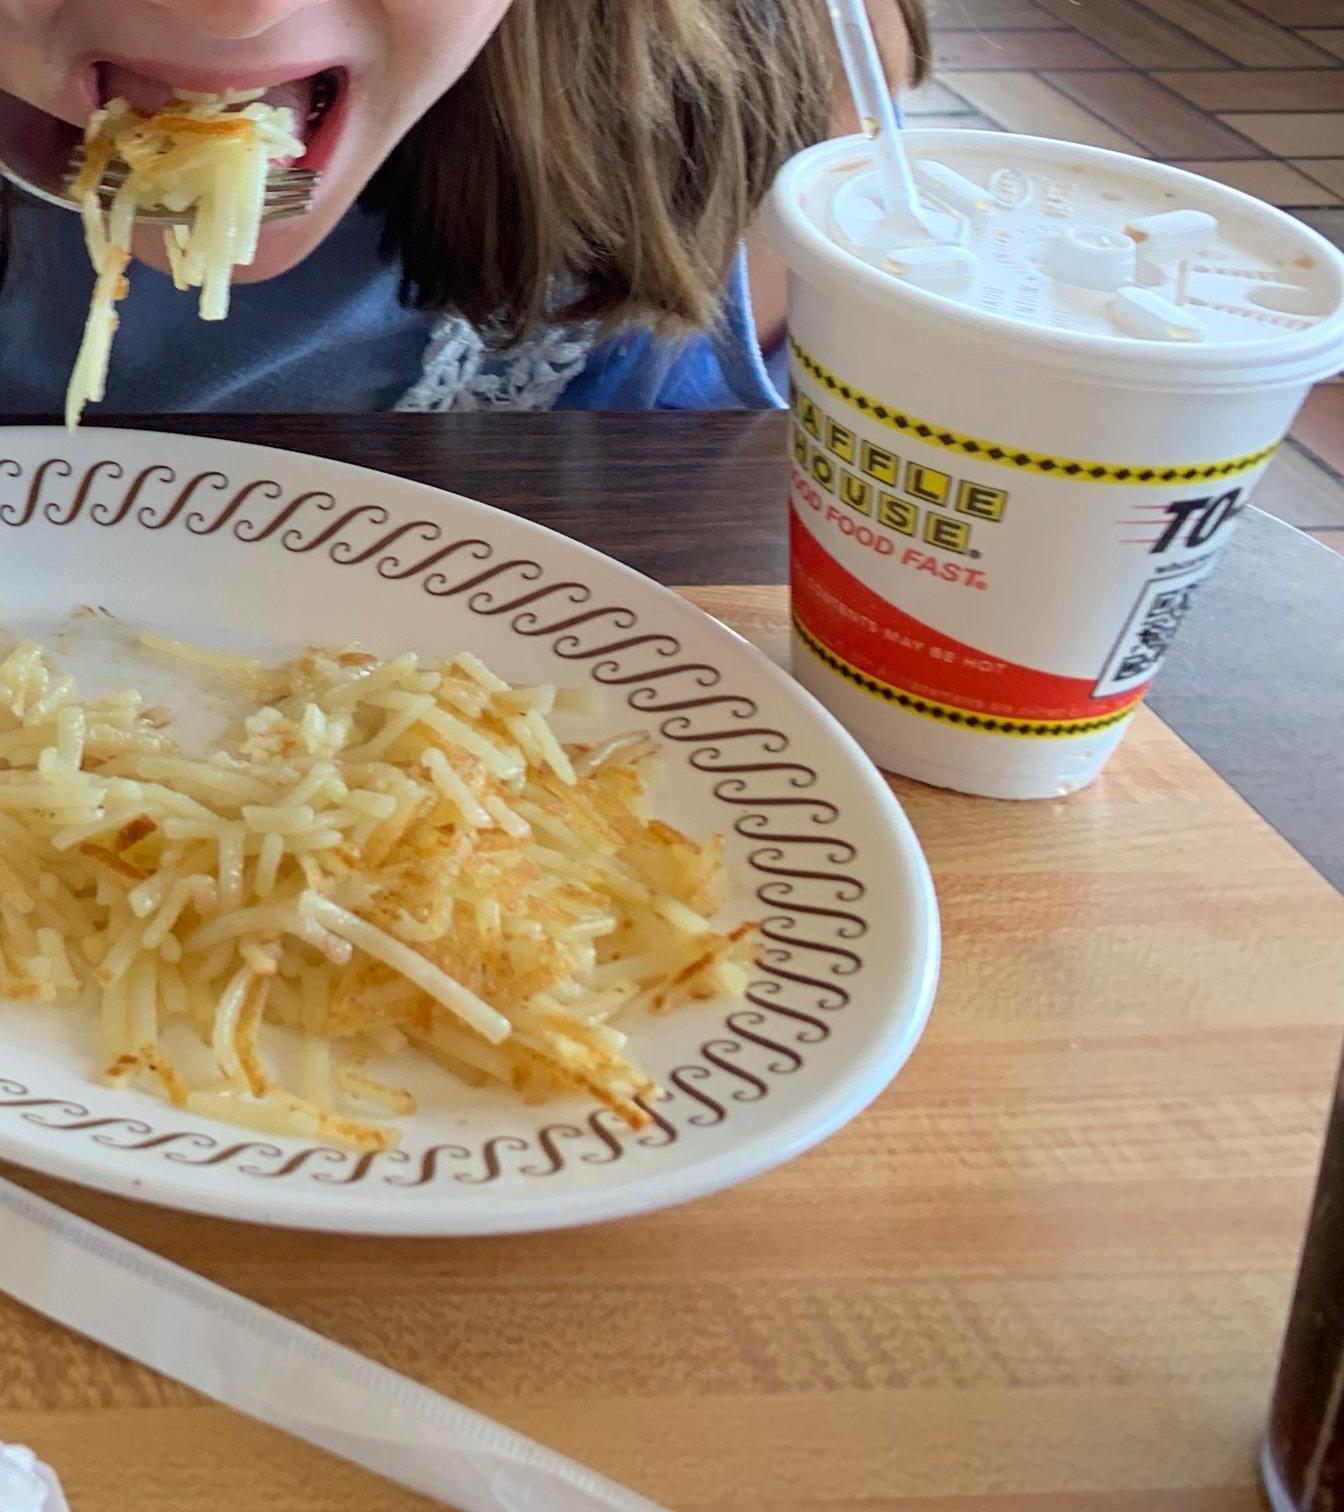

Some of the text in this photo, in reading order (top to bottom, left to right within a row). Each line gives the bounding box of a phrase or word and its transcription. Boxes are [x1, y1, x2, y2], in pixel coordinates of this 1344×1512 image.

[792, 388, 1006, 521] AFFLE
[826, 505, 895, 556] FOOD
[883, 627, 926, 652] MAY
[929, 646, 957, 664] BE
[962, 656, 1009, 674] HOT
